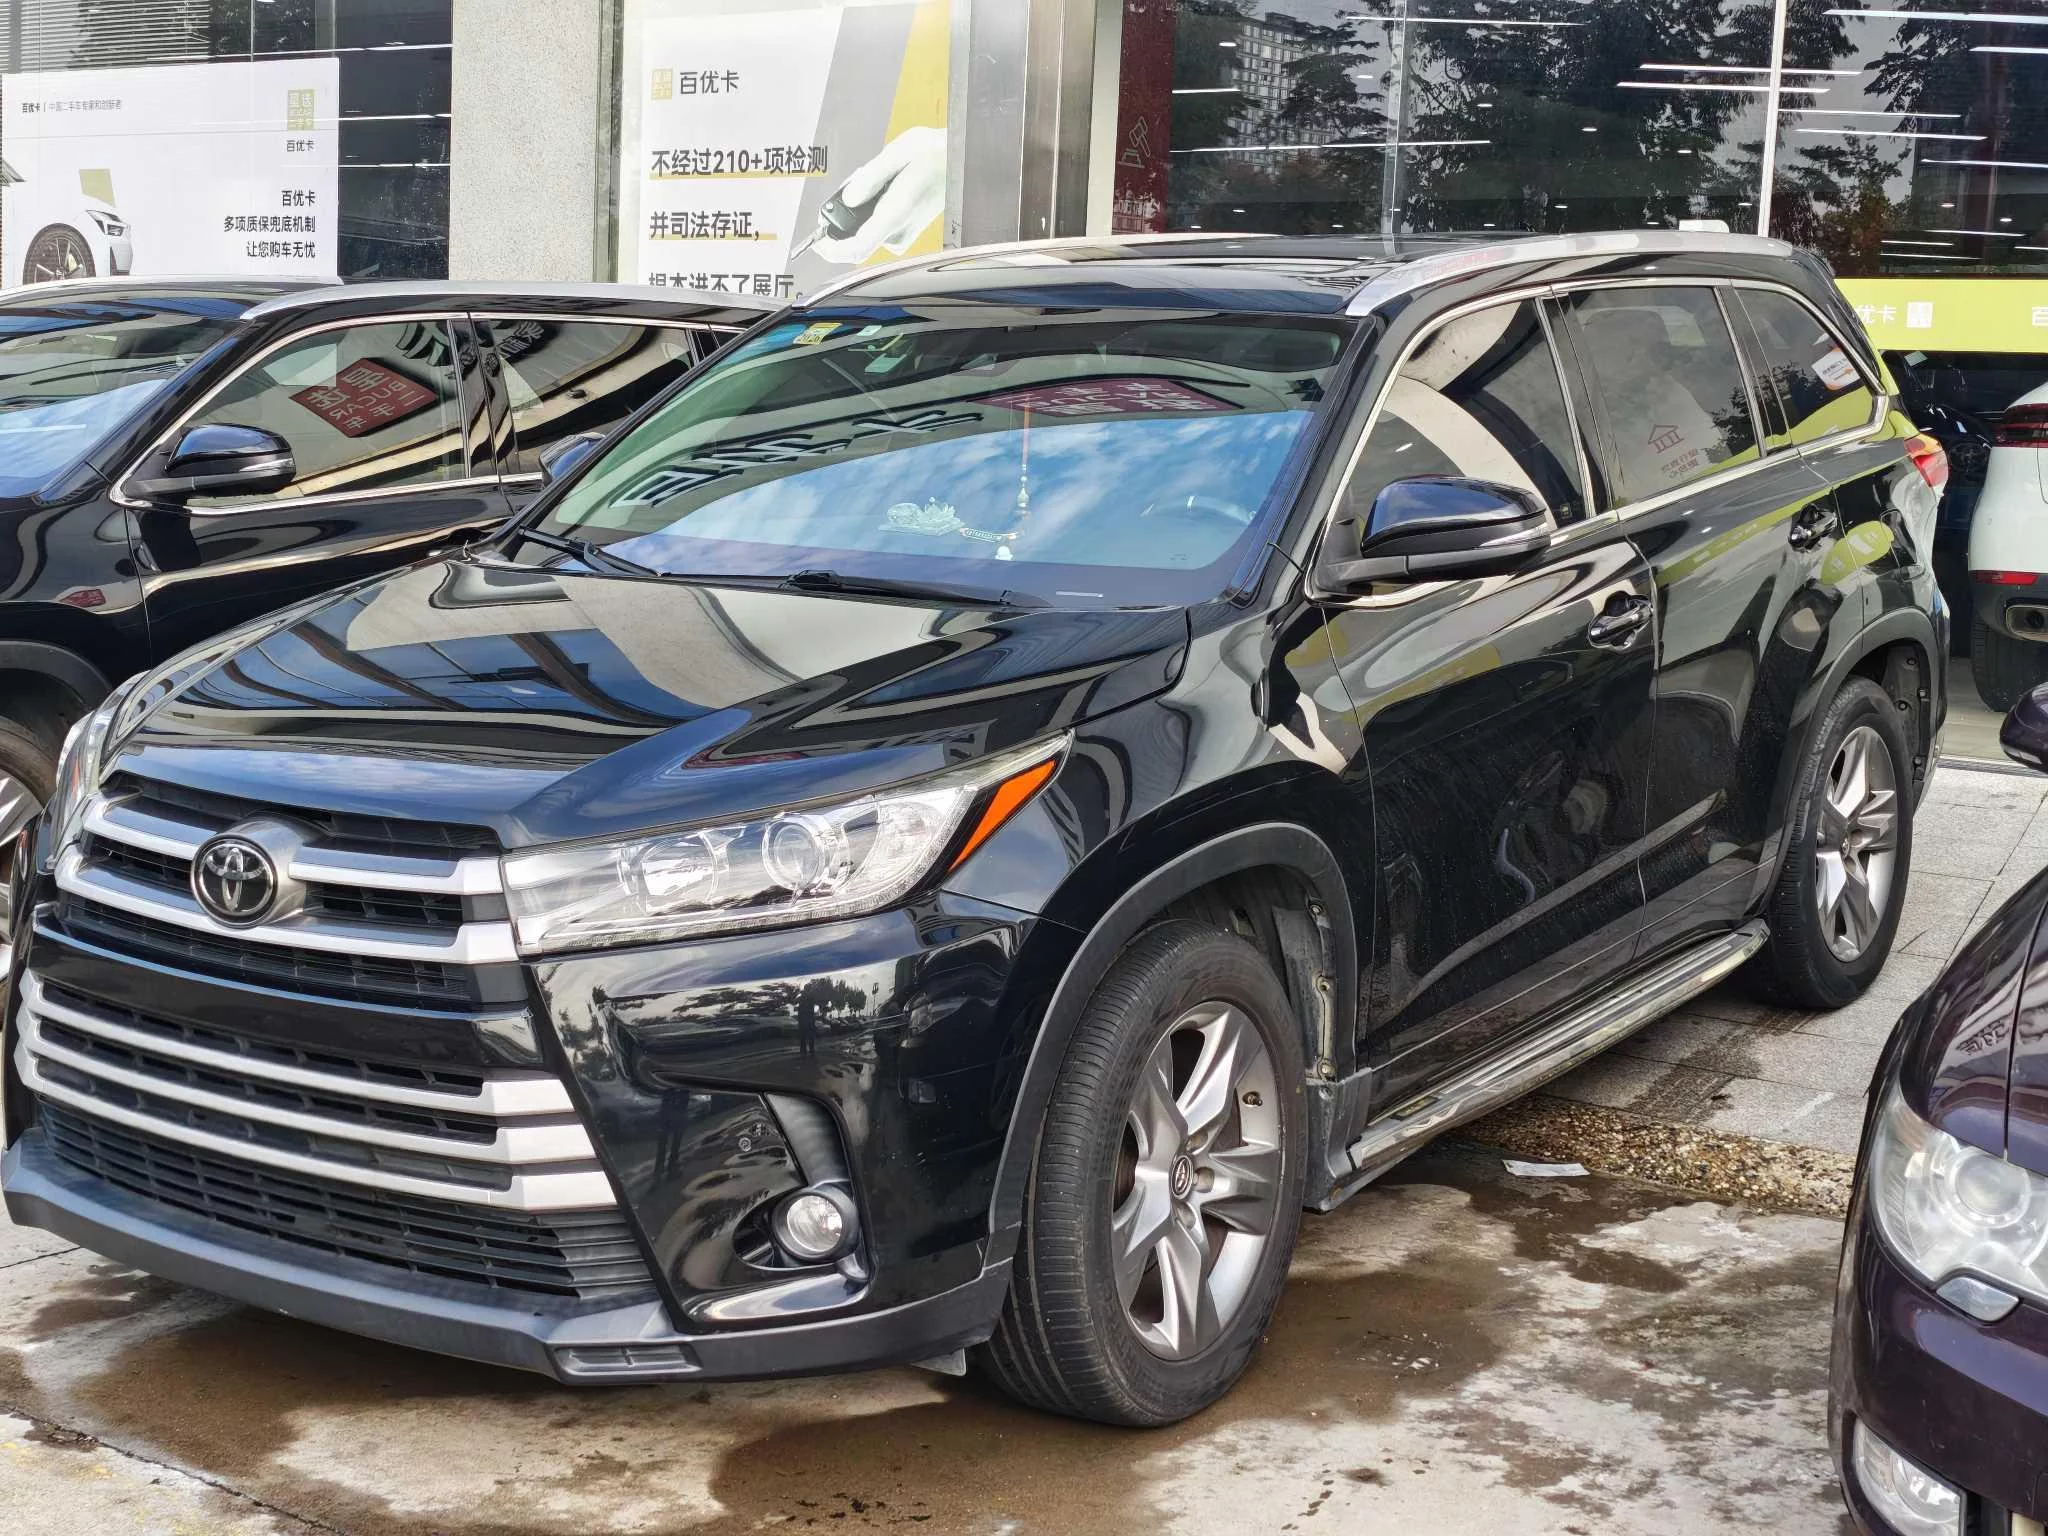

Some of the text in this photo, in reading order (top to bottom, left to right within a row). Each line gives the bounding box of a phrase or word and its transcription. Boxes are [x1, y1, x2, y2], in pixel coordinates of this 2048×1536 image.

[680, 69, 739, 94] 百优卡
[22, 103, 40, 113] 百优卡
[286, 139, 315, 152] 百优卡
[651, 145, 828, 177] 不经过210+项检测
[281, 189, 316, 207] 百优卡
[223, 215, 316, 233] 多项质保兜底机制
[246, 240, 316, 258] 让您购车无忧
